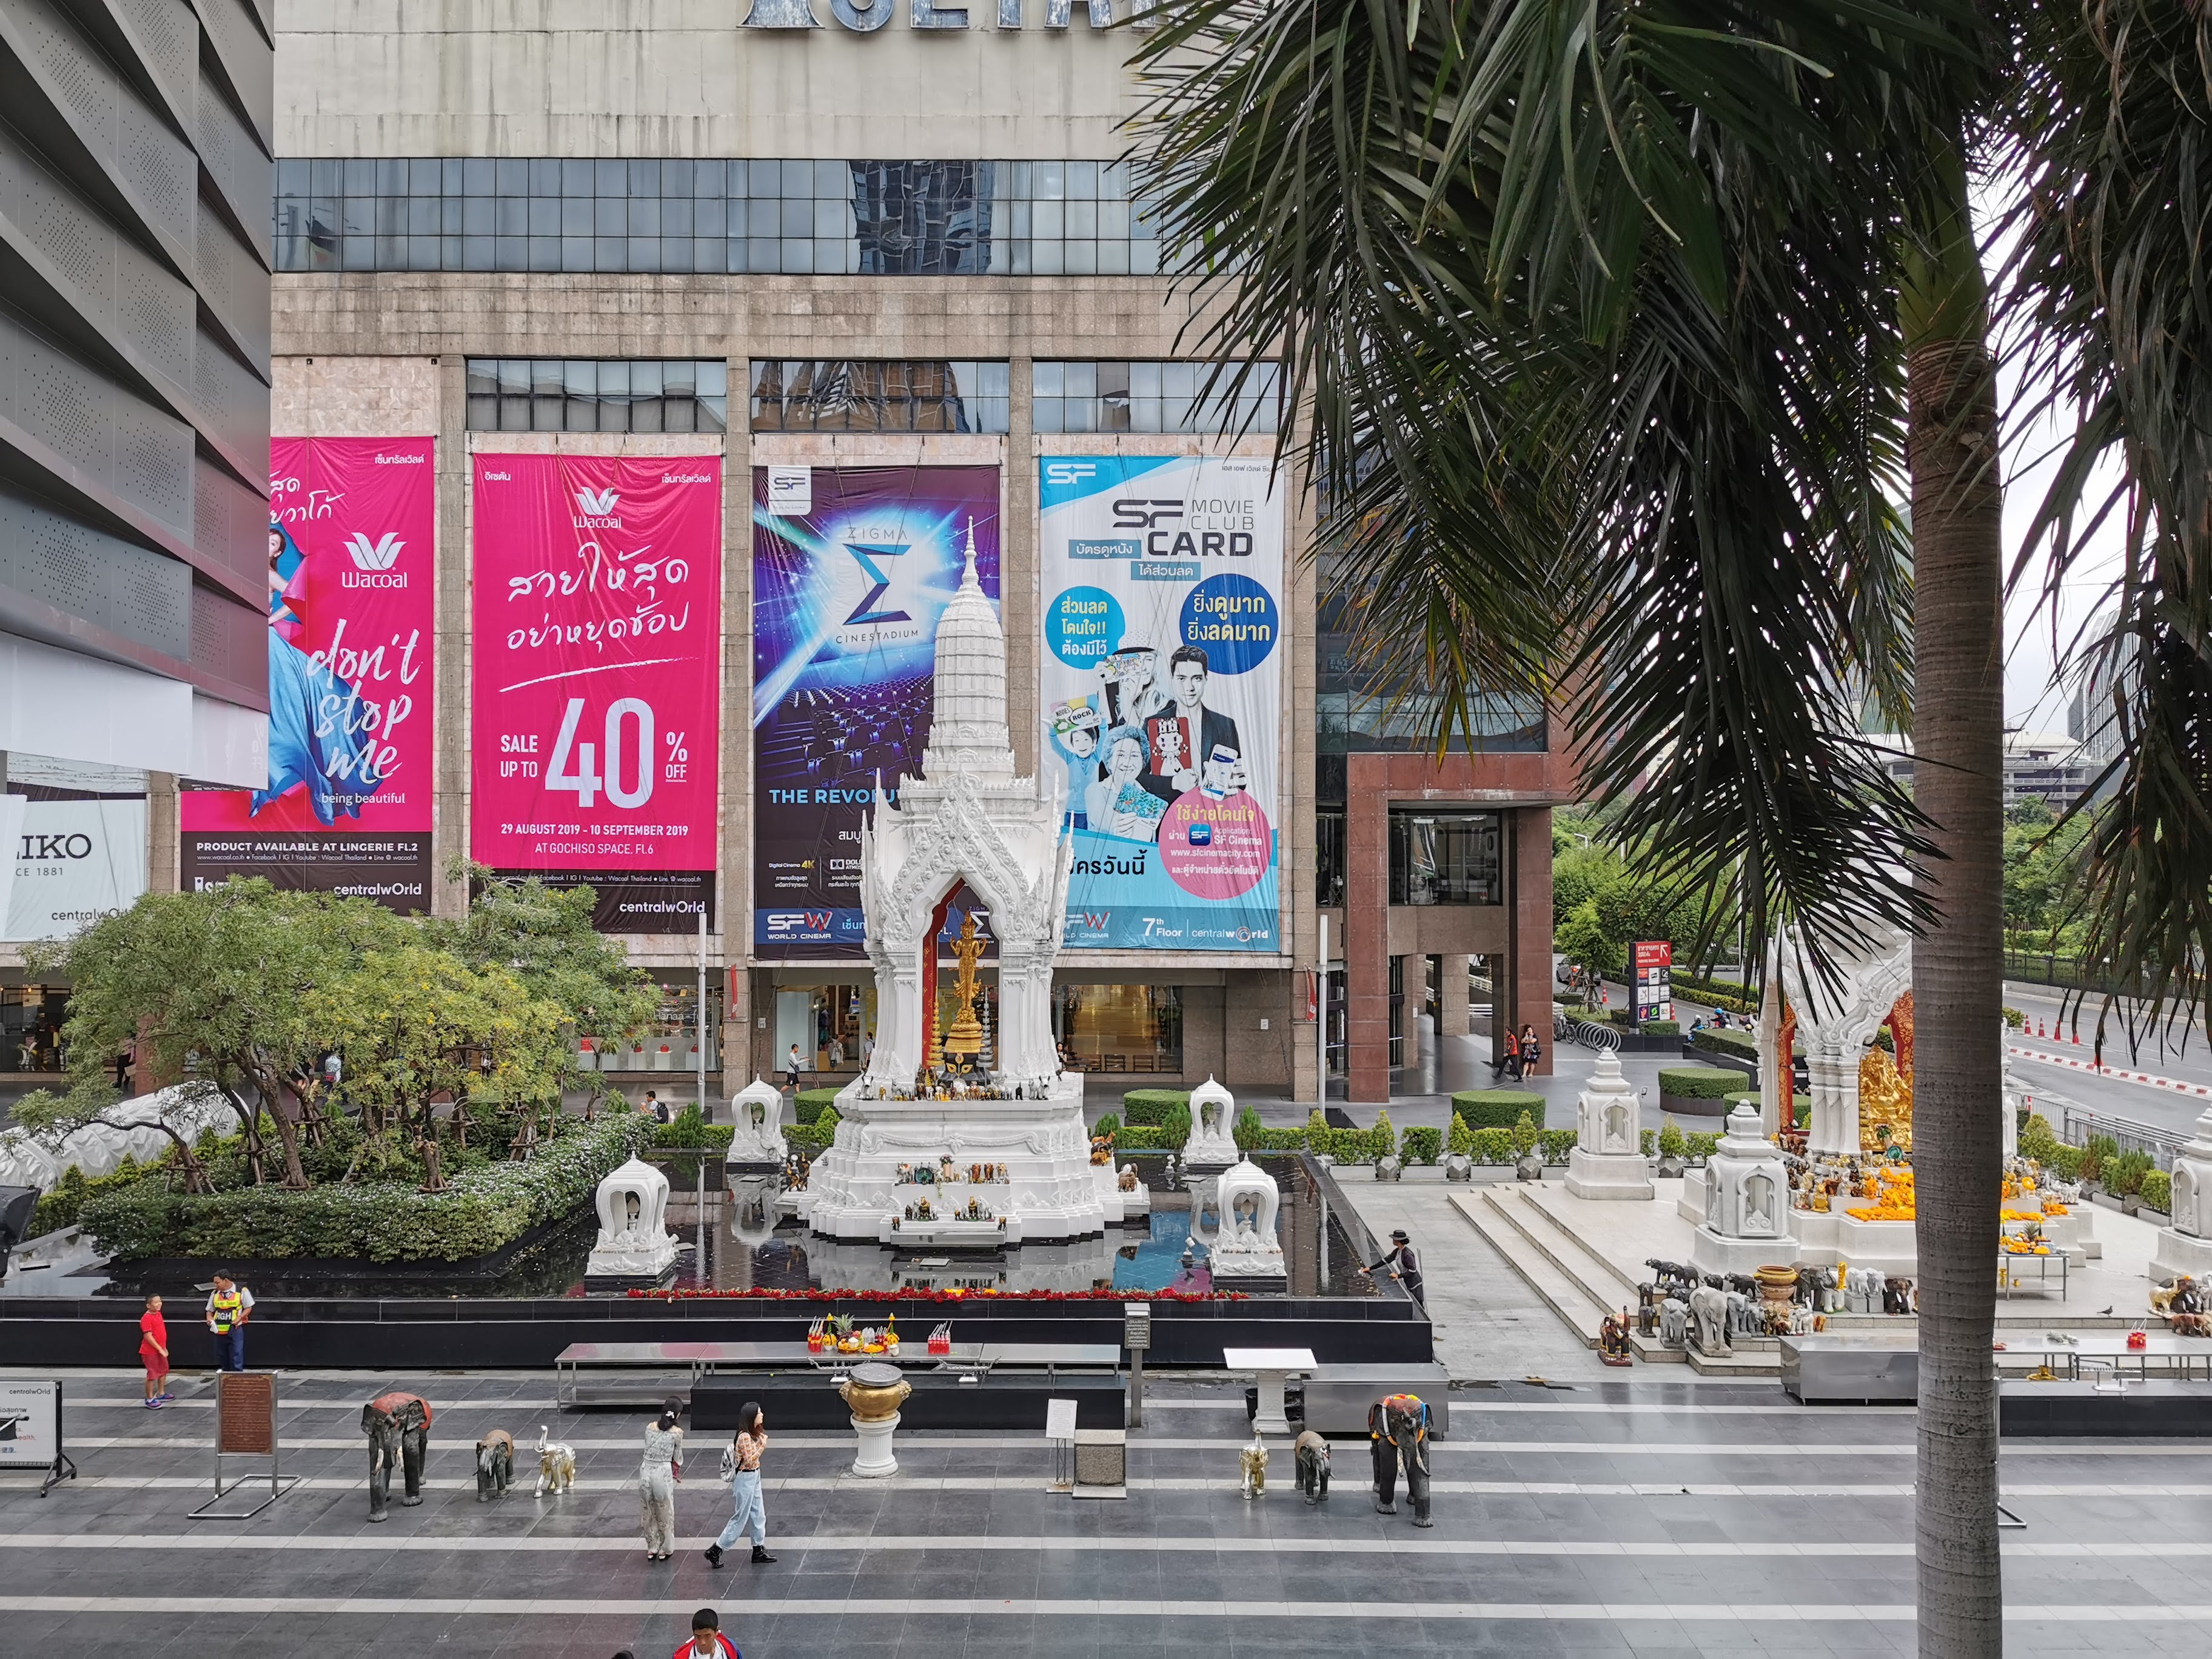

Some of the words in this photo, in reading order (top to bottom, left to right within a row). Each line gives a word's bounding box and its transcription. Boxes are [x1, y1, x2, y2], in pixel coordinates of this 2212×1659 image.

[375, 453, 424, 464] เซ็นทรัลเวิลด์
[484, 471, 511, 481] อิเซตัน
[662, 472, 711, 484] เซ็นทรัลเวิลด์
[1047, 464, 1096, 484] SF
[774, 477, 806, 490] SF
[1113, 499, 1183, 528] SF
[1192, 500, 1255, 514] MOVIE
[574, 515, 622, 529] Wacoal
[1191, 516, 1255, 531] CLUB
[848, 527, 908, 540] ZIGMA
[1076, 541, 1133, 558] บัตรดูหนัง
[1148, 531, 1253, 557] CARD
[1139, 563, 1194, 576] ได้ส่วนลด
[341, 571, 407, 588] Wacoal
[1061, 595, 1108, 614] ส่วนลด
[1193, 588, 1266, 621] ยิ่งดูมาก
[1062, 618, 1106, 635] โดนใจ!!
[1187, 618, 1271, 642] ยิ่งลดมาก
[835, 629, 919, 644] CINESTADIUM
[306, 618, 424, 689] don't
[1062, 638, 1107, 656] ต้องมีไว้
[314, 679, 413, 741] stop
[1072, 709, 1091, 720] ROCK
[500, 734, 538, 753] SALE
[545, 697, 655, 809] 40
[325, 738, 403, 784] me
[500, 760, 518, 778] UP
[520, 760, 538, 778] TO
[665, 764, 687, 779] OFF
[321, 793, 353, 806] being
[355, 793, 406, 804] beautiful
[768, 789, 809, 804] THE
[815, 789, 898, 804] REVOLU
[500, 823, 514, 835] 29
[515, 824, 556, 835] AUGUST
[557, 824, 580, 836] 2019
[589, 825, 600, 836] 10
[603, 825, 664, 836] SEPTEMBER
[666, 825, 689, 836] 2019
[838, 831, 862, 844] สมบู
[1214, 835, 1227, 845] SF
[1228, 835, 1262, 846] Cinema
[16, 833, 92, 860] IKO
[196, 842, 252, 851] PRODUCT
[255, 842, 319, 851] AVAILABLE
[322, 843, 337, 851] AT
[340, 843, 394, 851] LINGERIE
[535, 842, 548, 854] AT
[549, 843, 595, 854] GOCHISO
[1170, 849, 1261, 859] www.sfcinemacity.com
[1070, 849, 1148, 876] ครวันนี้
[36, 867, 64, 877] 1881
[1156, 927, 1183, 937] Floor
